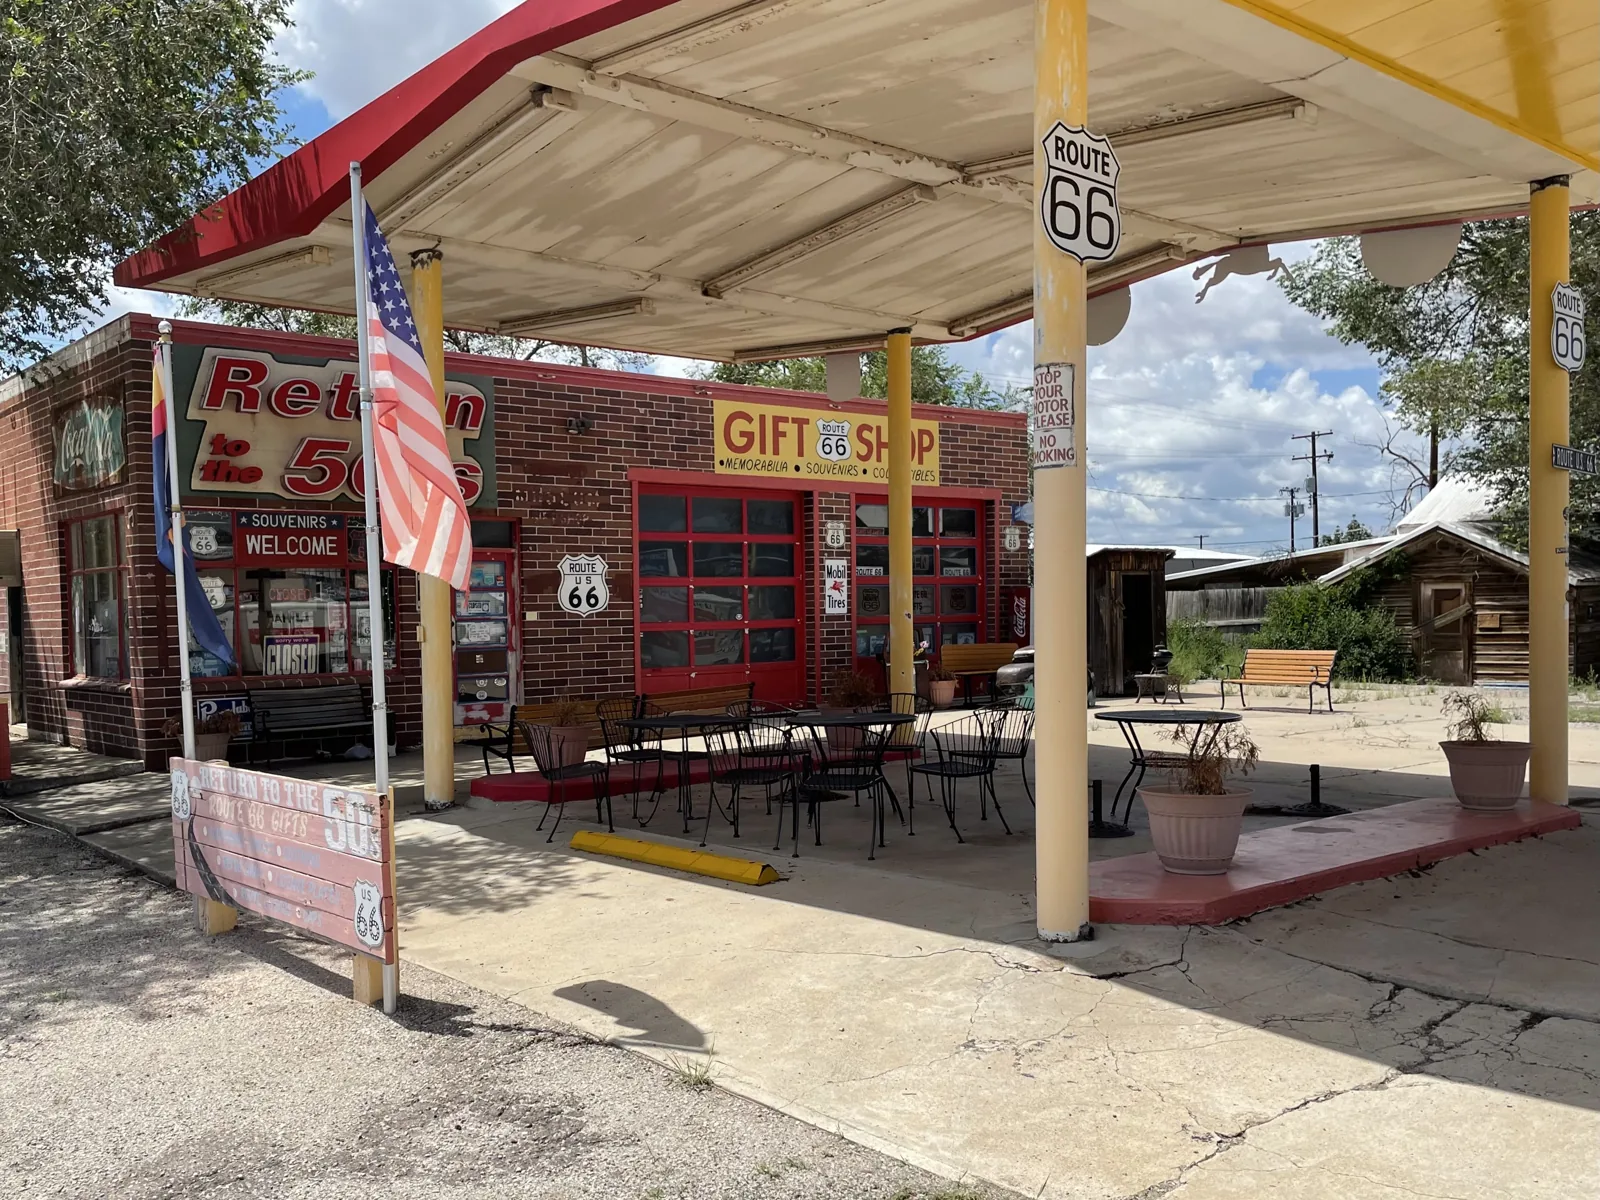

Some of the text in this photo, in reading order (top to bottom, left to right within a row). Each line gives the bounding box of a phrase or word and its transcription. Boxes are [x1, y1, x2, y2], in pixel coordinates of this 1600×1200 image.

[1054, 135, 1110, 177] ROUTE
[1050, 175, 1115, 250] 66
[1557, 291, 1581, 314] ROUTE
[1555, 316, 1583, 362] 66
[202, 354, 486, 430] Retn
[1035, 384, 1063, 400] YOUR
[723, 411, 810, 458] GIFT
[822, 424, 845, 434] ROUTE
[209, 433, 250, 457] to
[821, 437, 847, 456] 66
[856, 423, 934, 465] SHP
[1040, 434, 1056, 448] NO
[200, 459, 263, 484] the
[725, 459, 935, 482] MEMORABILIA SOUVENIRS COLIBLES
[1556, 448, 1574, 468] ROUTE
[1586, 458, 1593, 472] 66
[252, 514, 327, 528] SOUVENIRS
[196, 541, 212, 550] 66
[246, 534, 338, 555] WELCOME
[831, 534, 840, 544] 66
[1008, 538, 1017, 548] 66
[569, 563, 597, 572] ROUTE
[826, 564, 846, 579] Mobil
[568, 586, 599, 608] 66
[827, 595, 845, 609] Tires
[267, 644, 317, 676] CLOSED
[173, 785, 189, 815] 66
[200, 767, 258, 801] RETURN
[261, 776, 280, 804] TO
[284, 781, 320, 813] THE
[208, 795, 244, 824] ROUTE
[271, 809, 309, 837] GIFTS
[356, 902, 379, 942] 66
